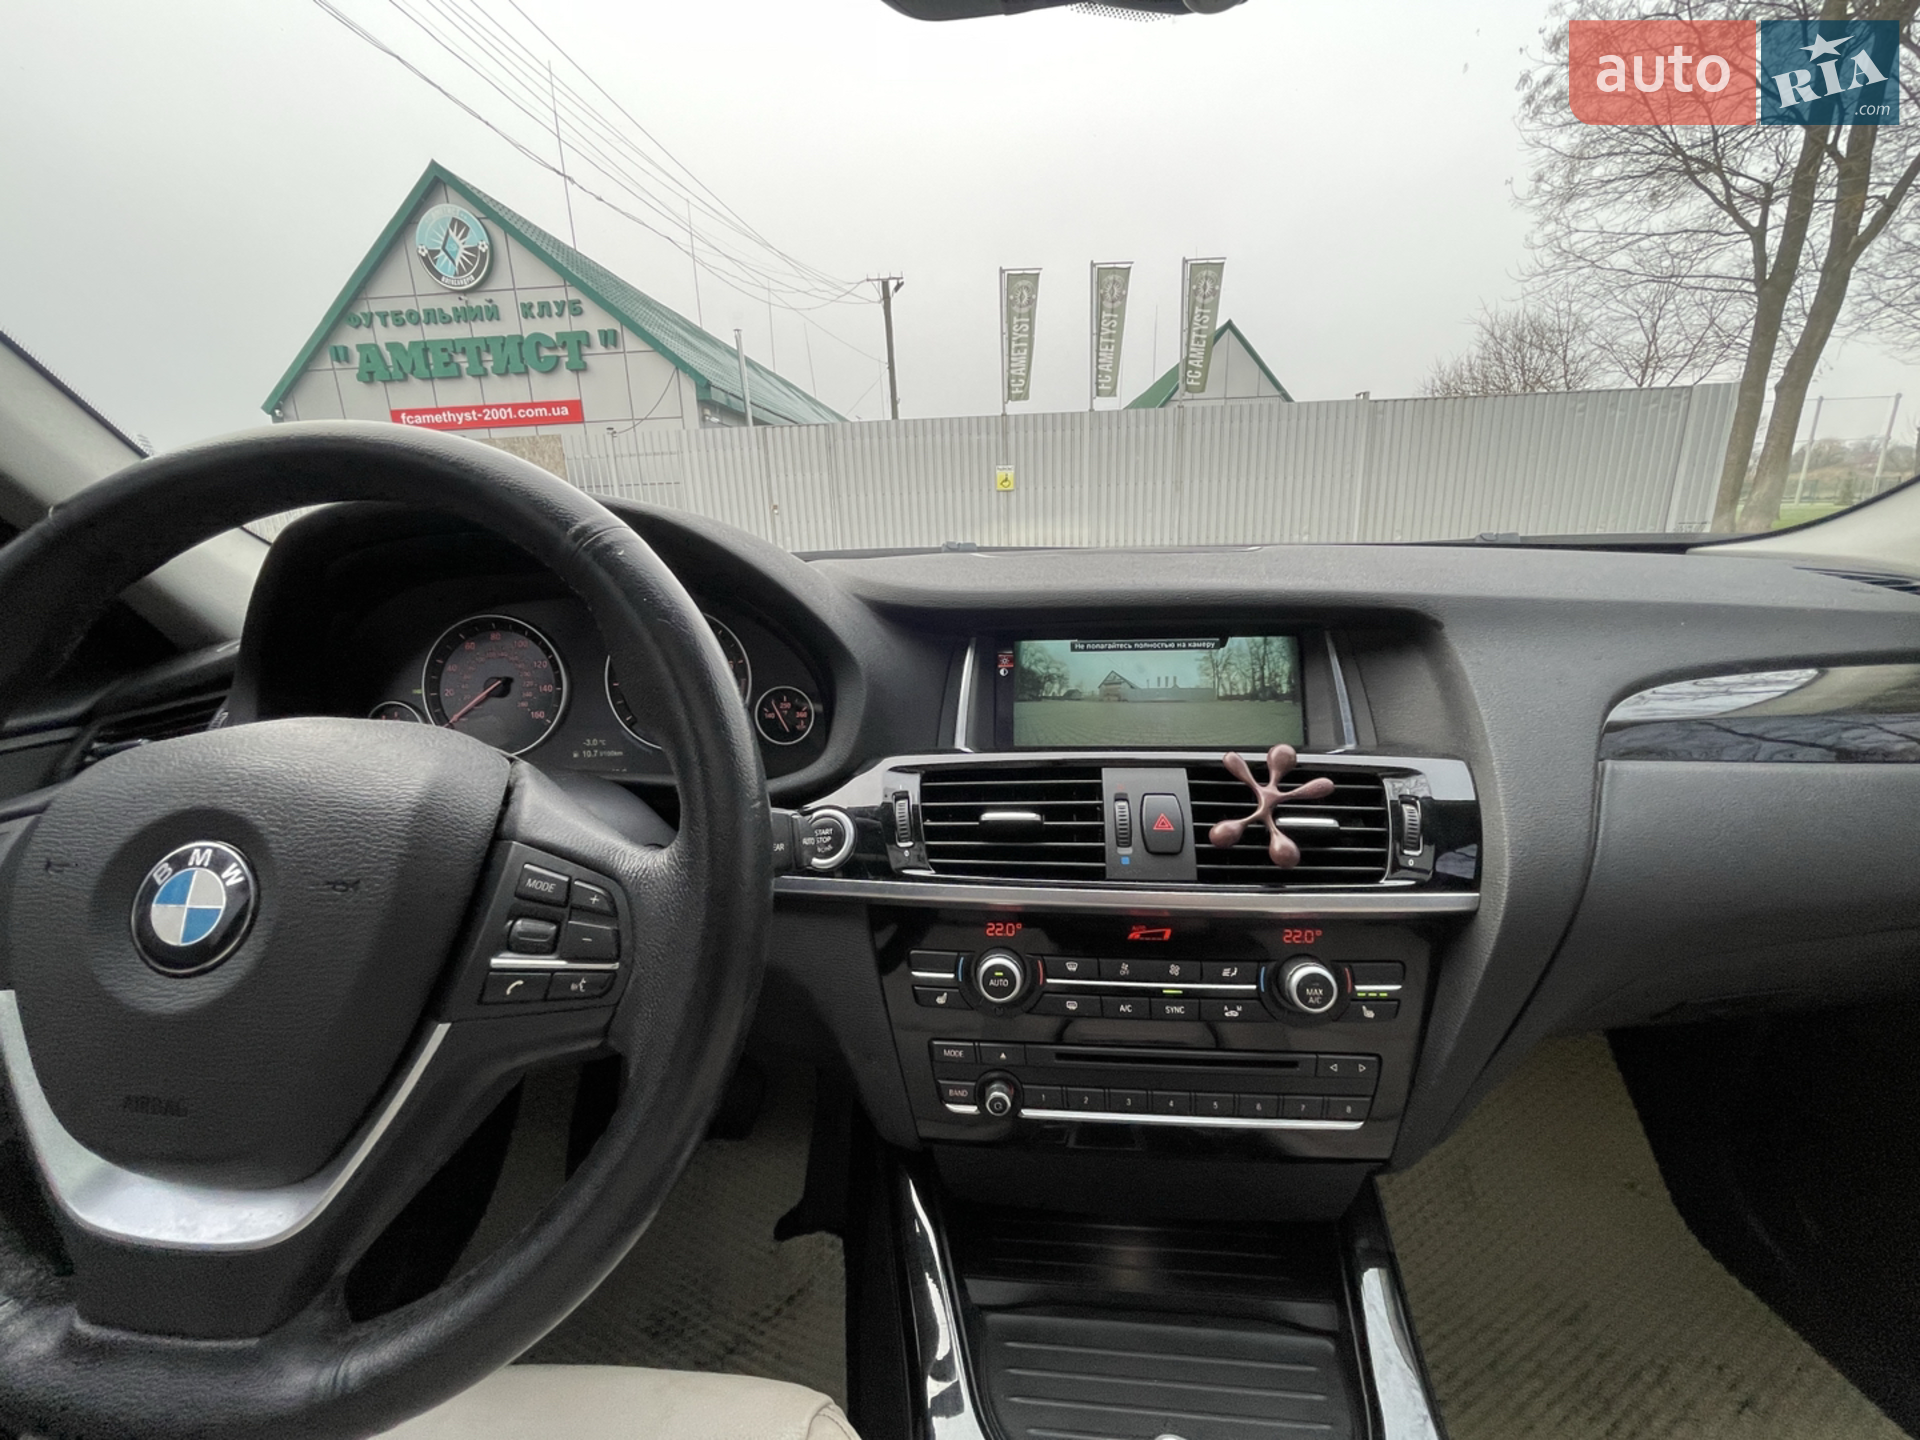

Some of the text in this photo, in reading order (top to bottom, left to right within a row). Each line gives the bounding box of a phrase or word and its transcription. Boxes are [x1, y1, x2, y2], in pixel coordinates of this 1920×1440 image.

[347, 298, 584, 329] ФУТБОЛЬНИЙ КЛУБ
[1010, 316, 1030, 376] AMETYST
[1097, 311, 1118, 390] FC AMETYST
[1186, 306, 1211, 386] FC AMETYST
[401, 405, 570, 425] fcamethyst-2001.com.ua
[1086, 641, 1132, 651] полагайтесь
[1134, 641, 1175, 650] полностью
[1187, 641, 1216, 650] камеру
[533, 660, 548, 669] 120
[444, 688, 455, 697] 20
[539, 685, 553, 693] 140
[582, 749, 598, 758] 10.7
[814, 828, 833, 836] START
[153, 848, 245, 886] BMW
[525, 878, 557, 893] MODE
[988, 979, 1009, 987] AUTO
[1306, 988, 1324, 996] MAX
[1119, 1004, 1133, 1012] A/C
[1165, 1006, 1185, 1014] SYNC
[943, 1049, 964, 1057] MODE
[948, 1088, 968, 1097] BAND
